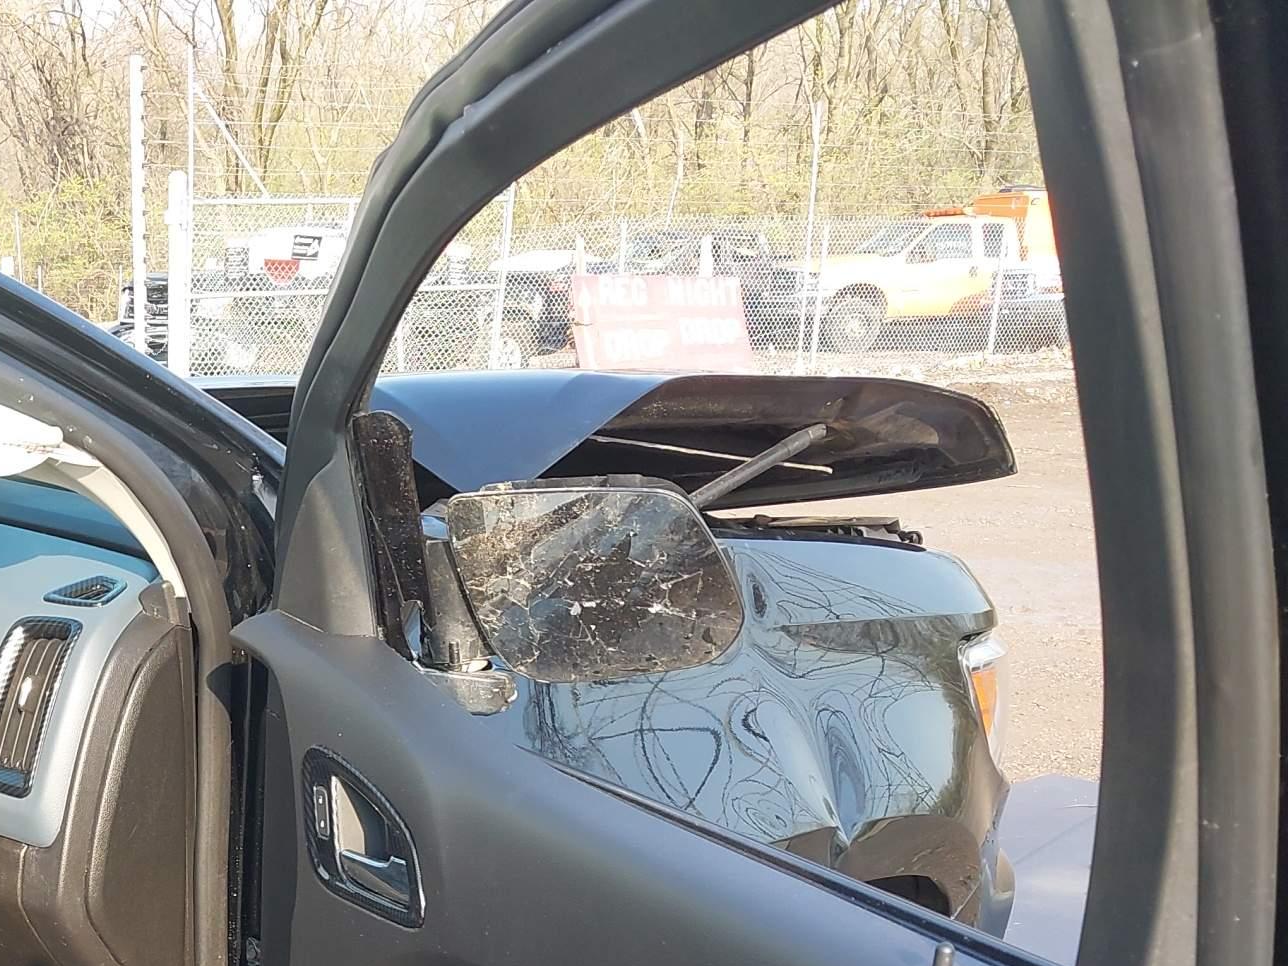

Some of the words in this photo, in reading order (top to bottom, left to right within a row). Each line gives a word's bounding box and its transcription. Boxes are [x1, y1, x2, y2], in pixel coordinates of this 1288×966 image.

[664, 276, 740, 306] NIGHT
[606, 328, 670, 360] DROP
[680, 317, 741, 345] DROP
